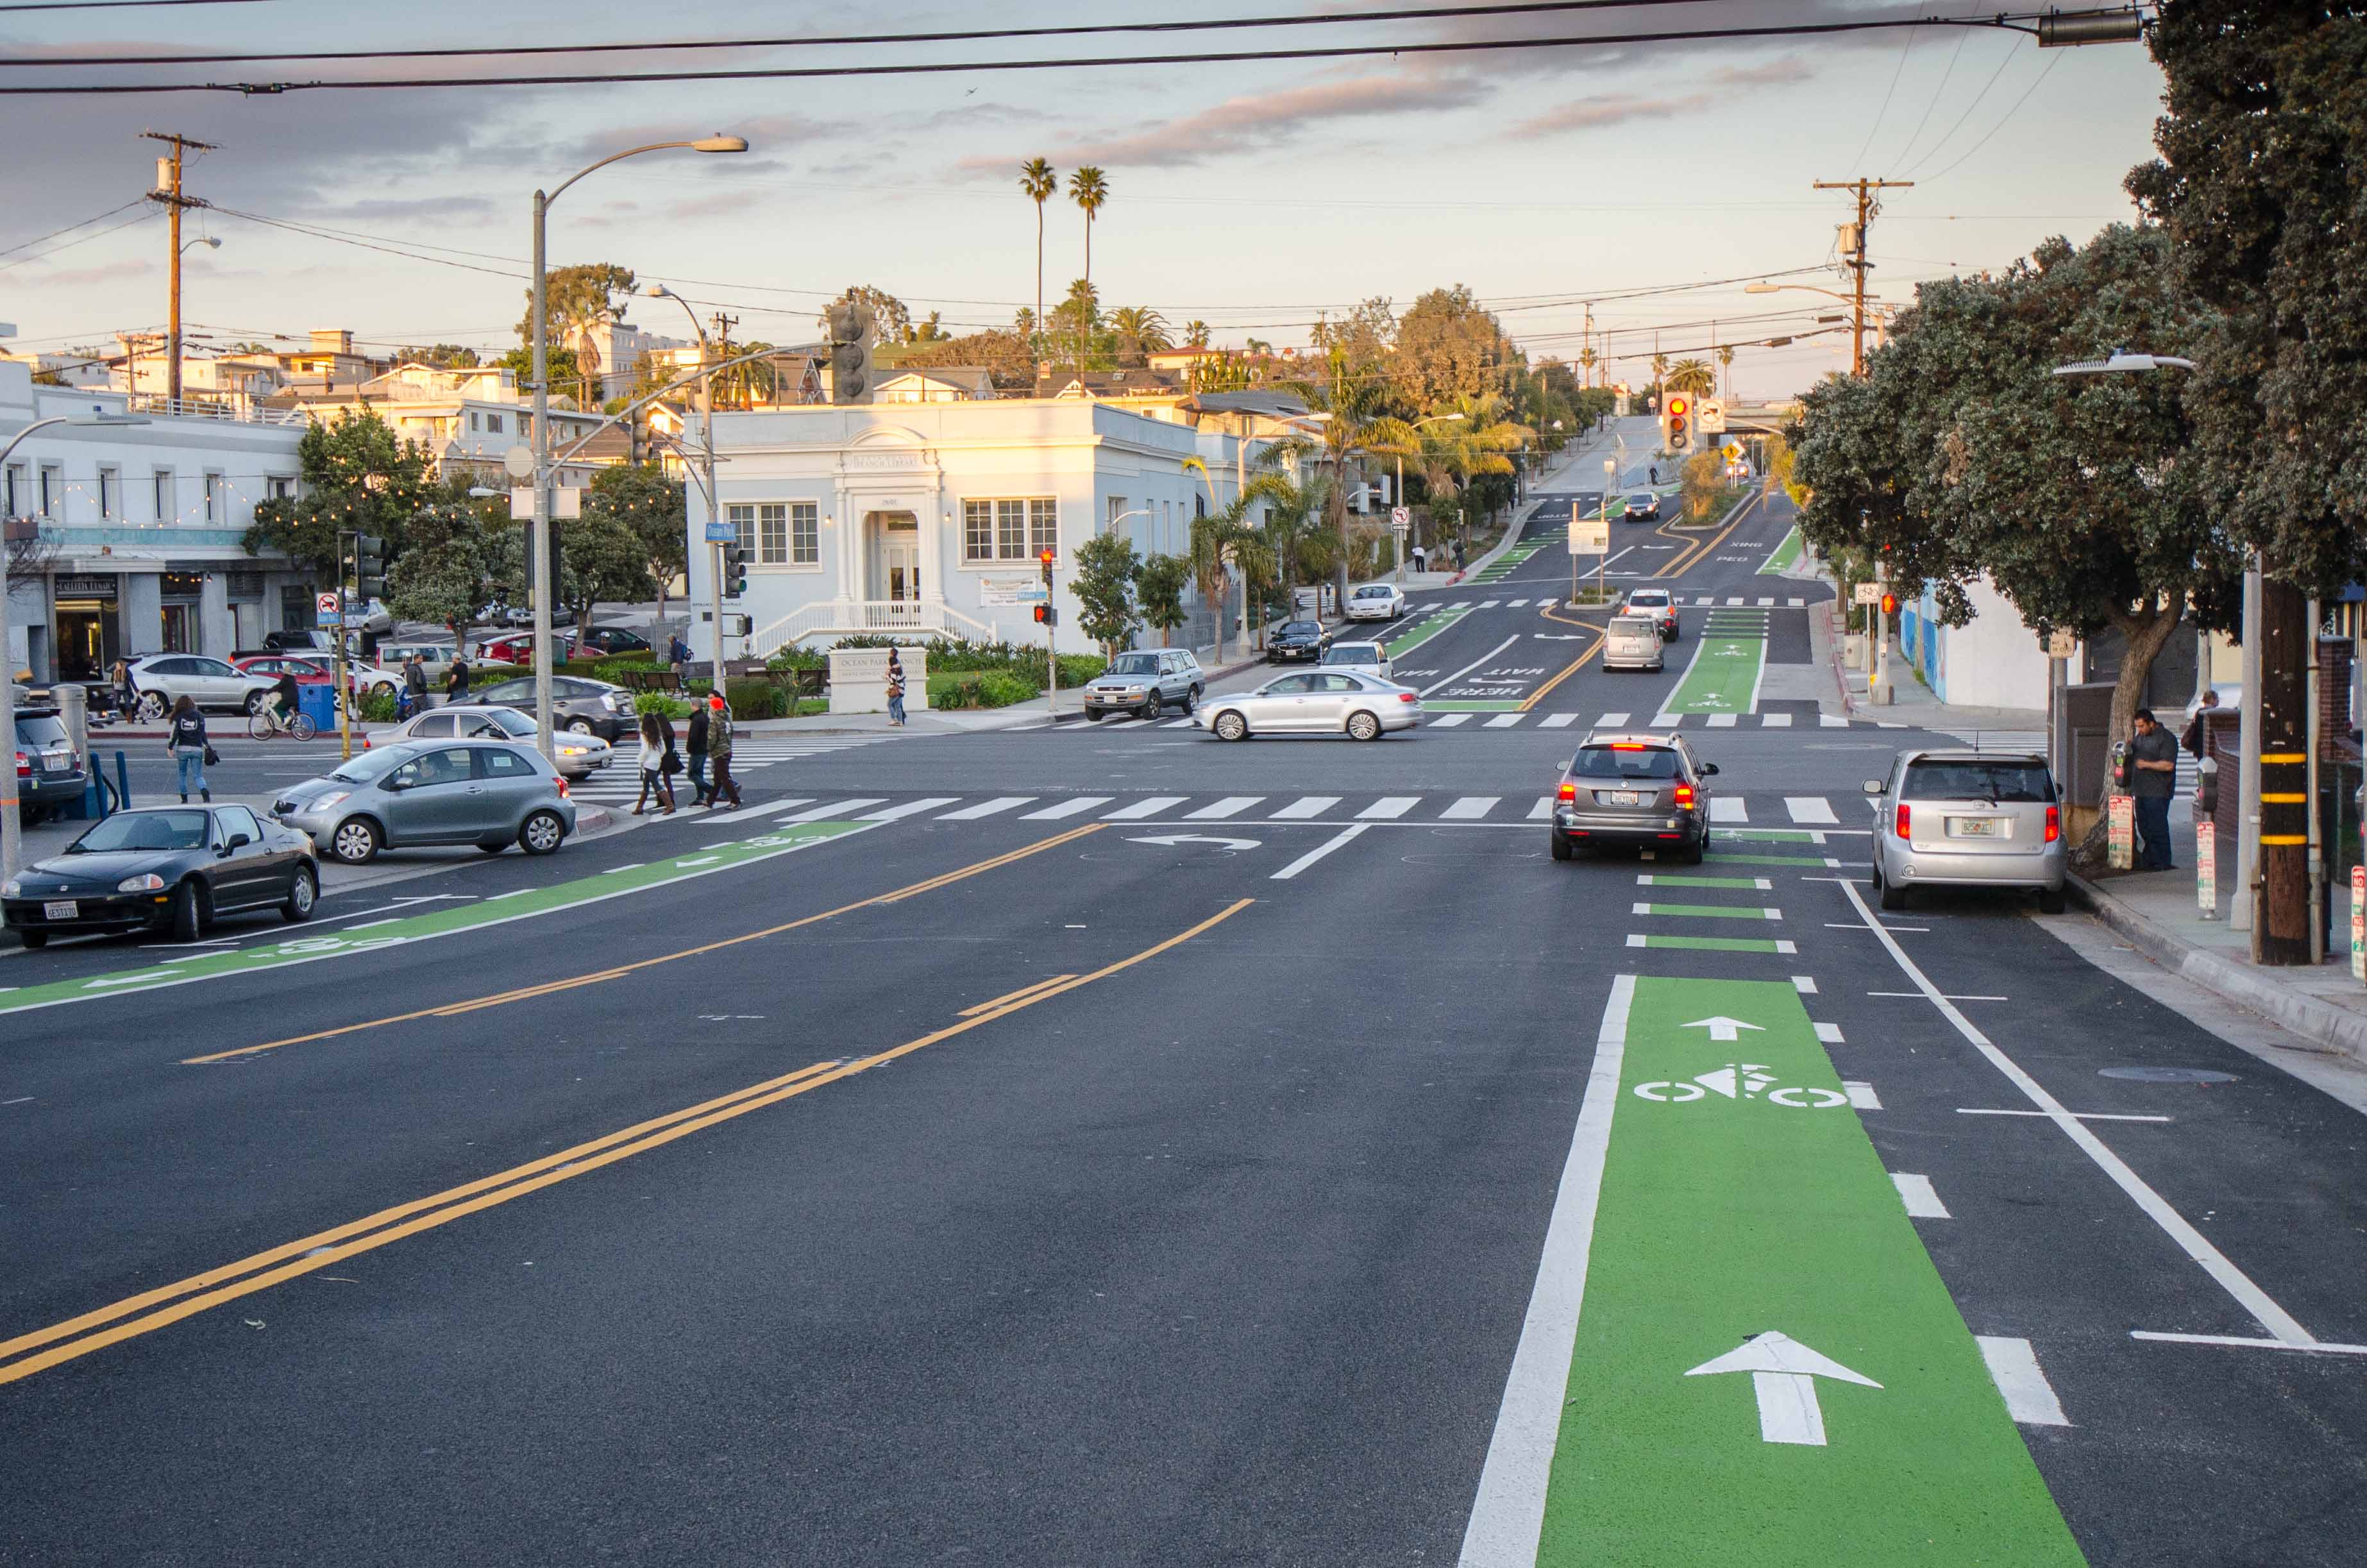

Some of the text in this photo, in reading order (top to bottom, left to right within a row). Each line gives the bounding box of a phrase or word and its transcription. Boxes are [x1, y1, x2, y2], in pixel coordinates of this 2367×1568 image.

[707, 525, 724, 537] Ocean
[841, 659, 867, 667] OCEAN
[1440, 687, 1524, 696] HERE
[2354, 878, 2364, 887] NO
